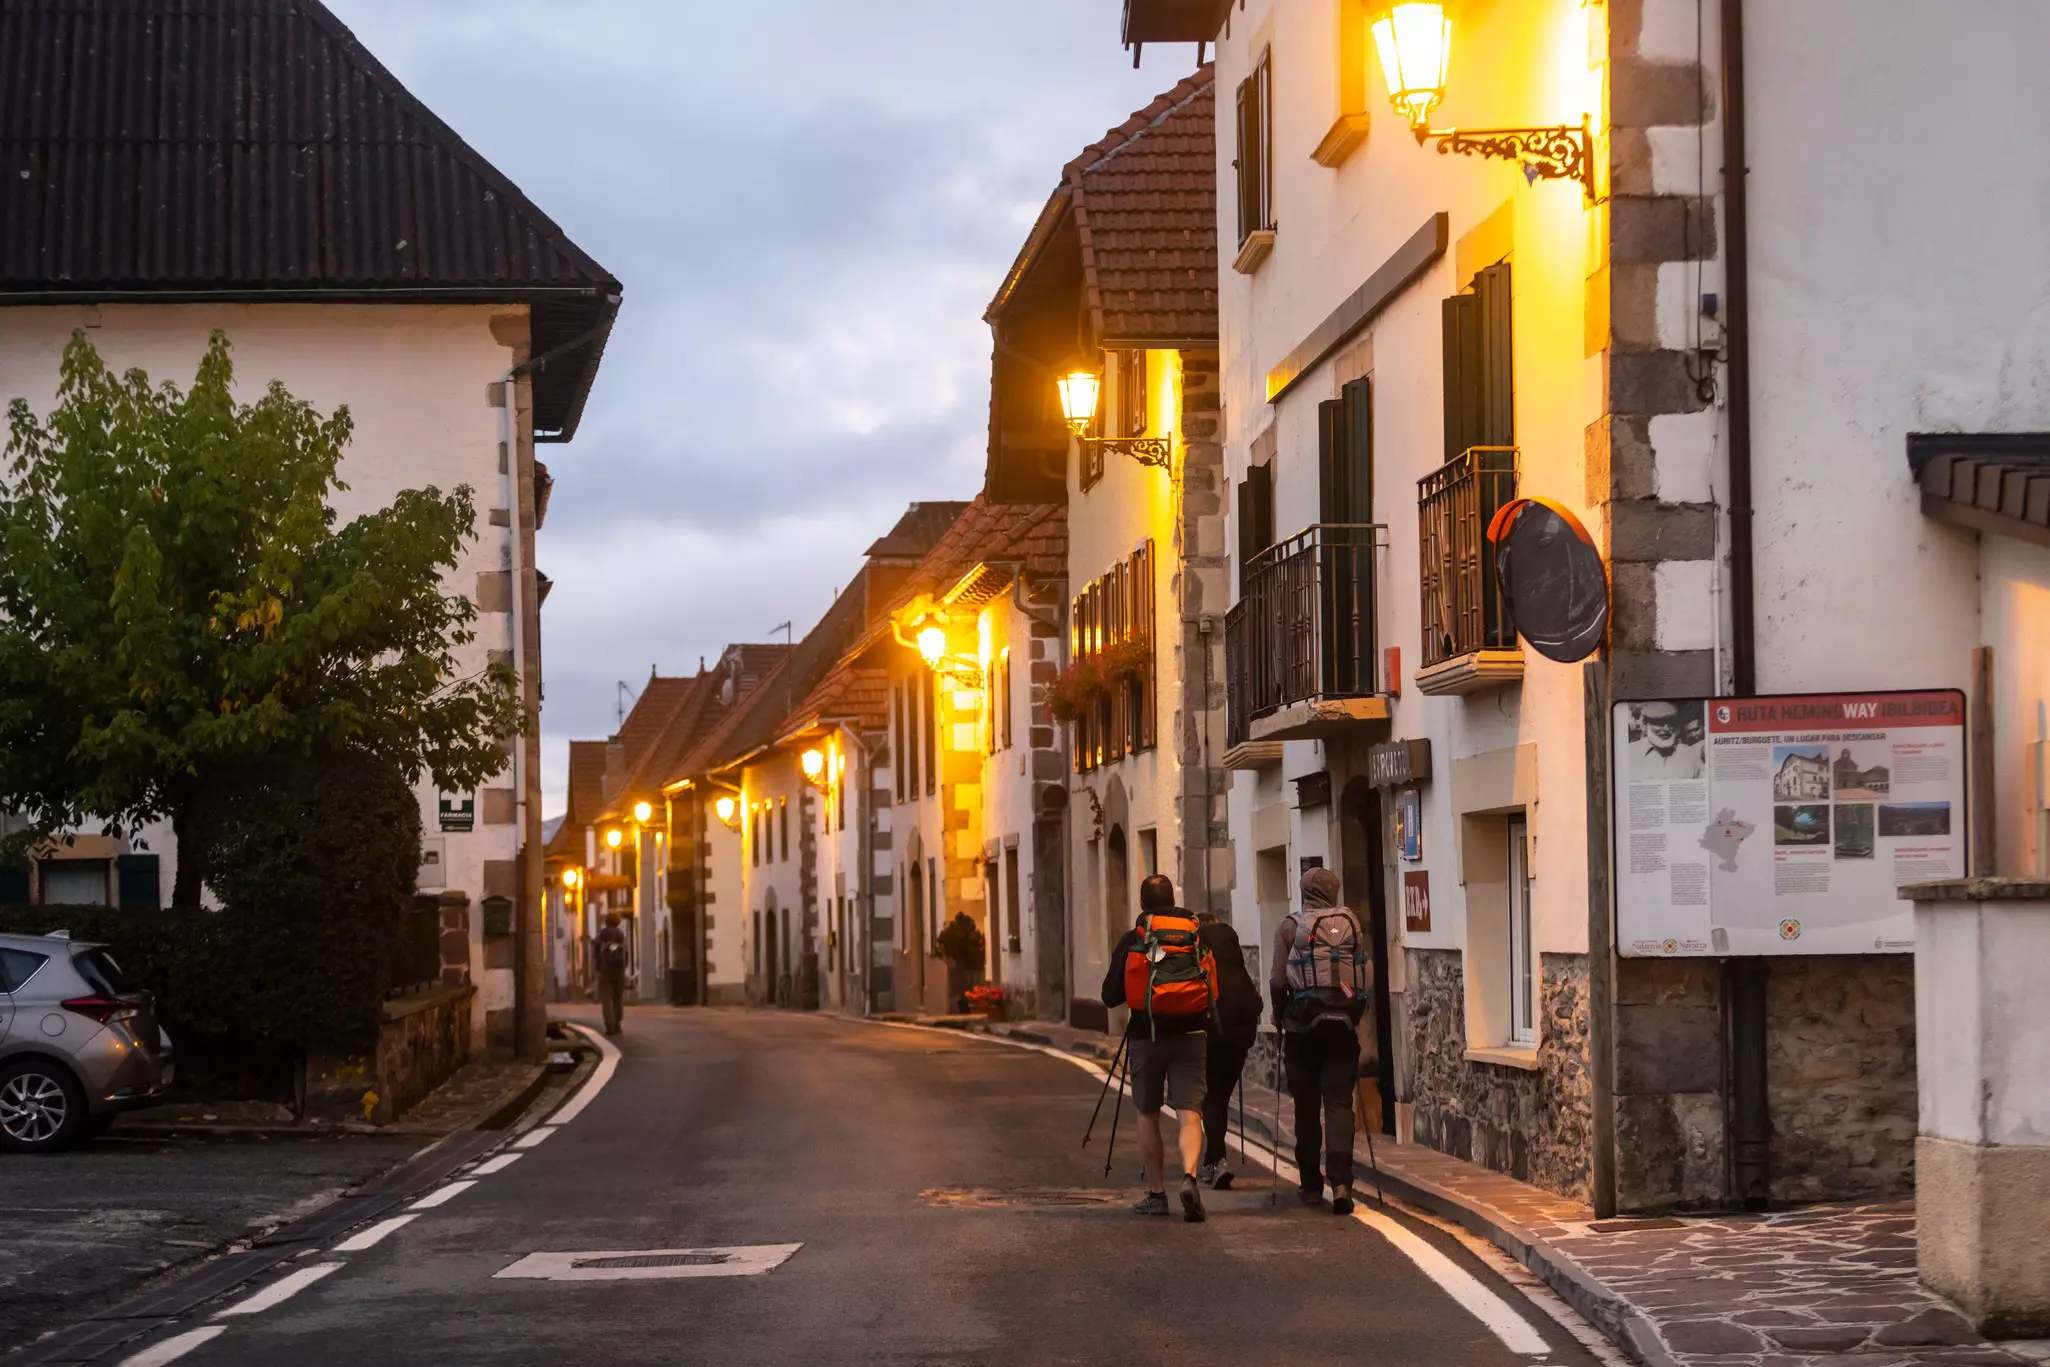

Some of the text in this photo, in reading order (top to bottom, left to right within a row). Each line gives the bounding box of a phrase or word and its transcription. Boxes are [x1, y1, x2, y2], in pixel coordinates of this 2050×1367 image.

[1737, 705, 1776, 723] RUTA
[1781, 701, 1878, 721] HEMINGWAY
[1796, 734, 1820, 742] LUGAR
[1407, 805, 1414, 837] H
